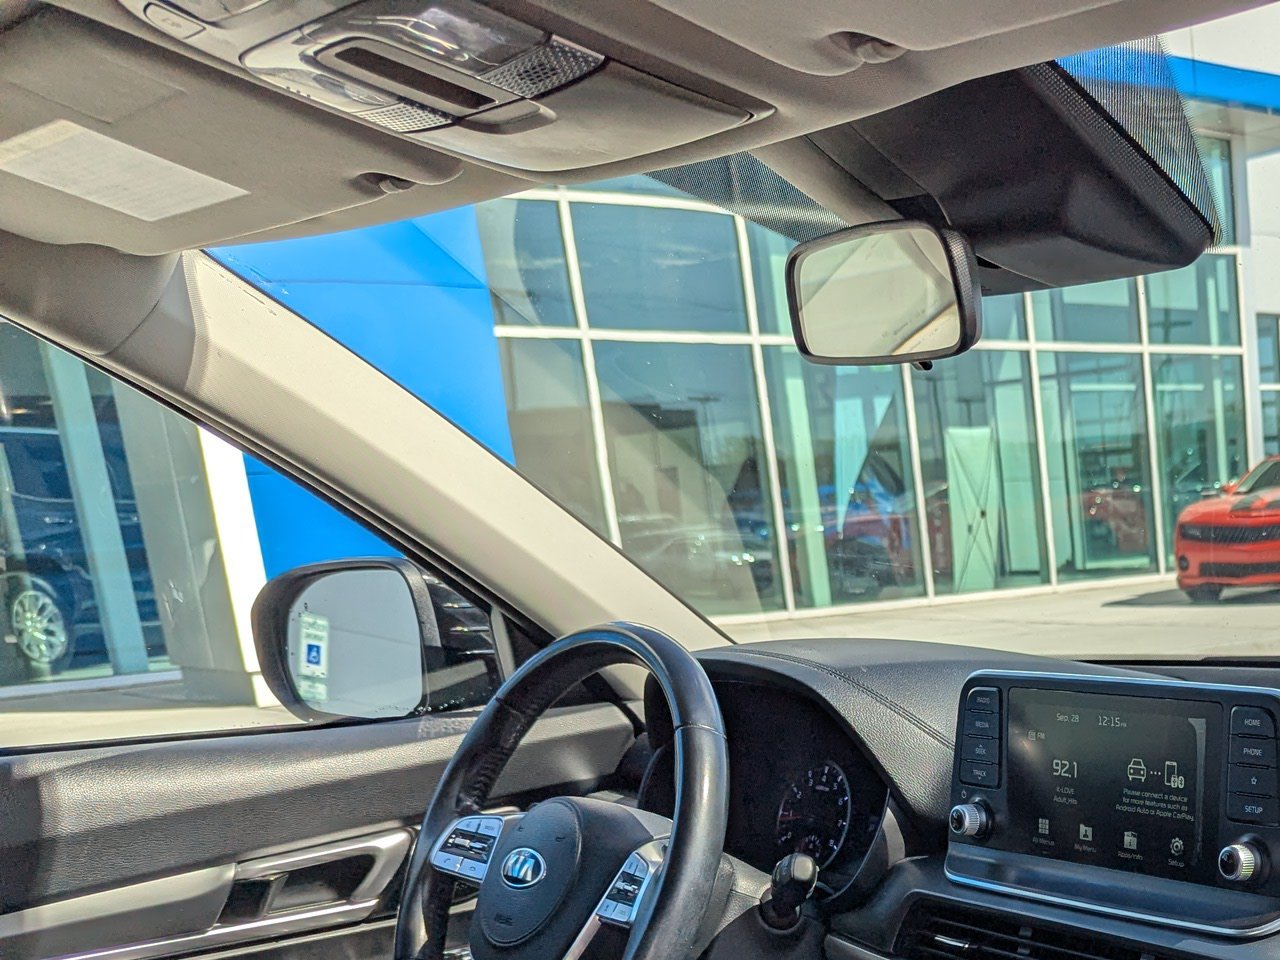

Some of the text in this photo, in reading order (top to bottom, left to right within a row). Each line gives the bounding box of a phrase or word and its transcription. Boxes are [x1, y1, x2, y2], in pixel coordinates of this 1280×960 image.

[1056, 712, 1080, 723] Sep. 28
[1098, 715, 1120, 727] 12:15
[1244, 719, 1261, 727] HOME
[975, 747, 986, 755] SEEK
[1243, 747, 1262, 756] PHONE
[972, 769, 986, 777] TRACK
[1052, 759, 1078, 778] 92.1
[1141, 791, 1163, 799] connect
[1169, 794, 1188, 802] device
[1115, 803, 1135, 812] Android
[1136, 806, 1149, 814] Auto
[1156, 810, 1172, 818] Apple
[1244, 805, 1263, 814] SETUP
